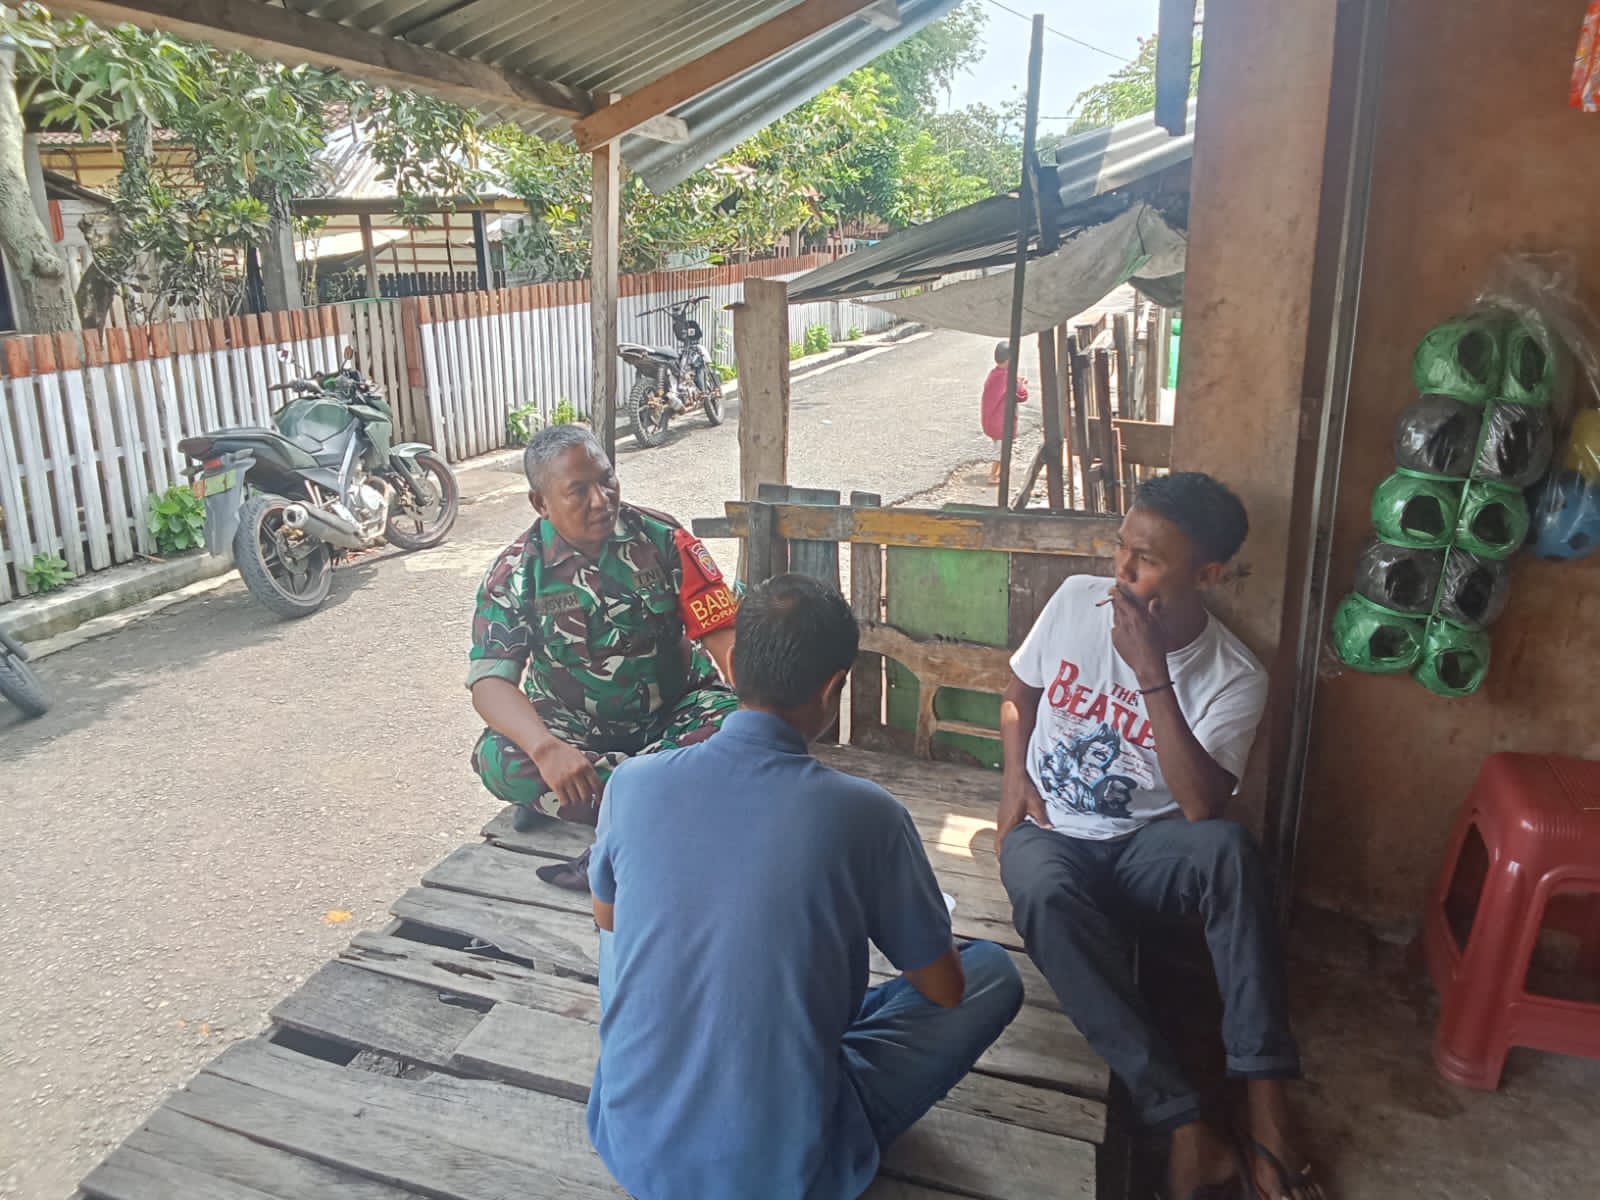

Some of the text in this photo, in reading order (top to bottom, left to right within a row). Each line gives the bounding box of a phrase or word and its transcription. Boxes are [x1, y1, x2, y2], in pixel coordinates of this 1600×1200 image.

[690, 587, 737, 621] BABI
[700, 605, 739, 629] KORA
[1048, 659, 1160, 752] BEATLE
[1111, 682, 1139, 706] THE
